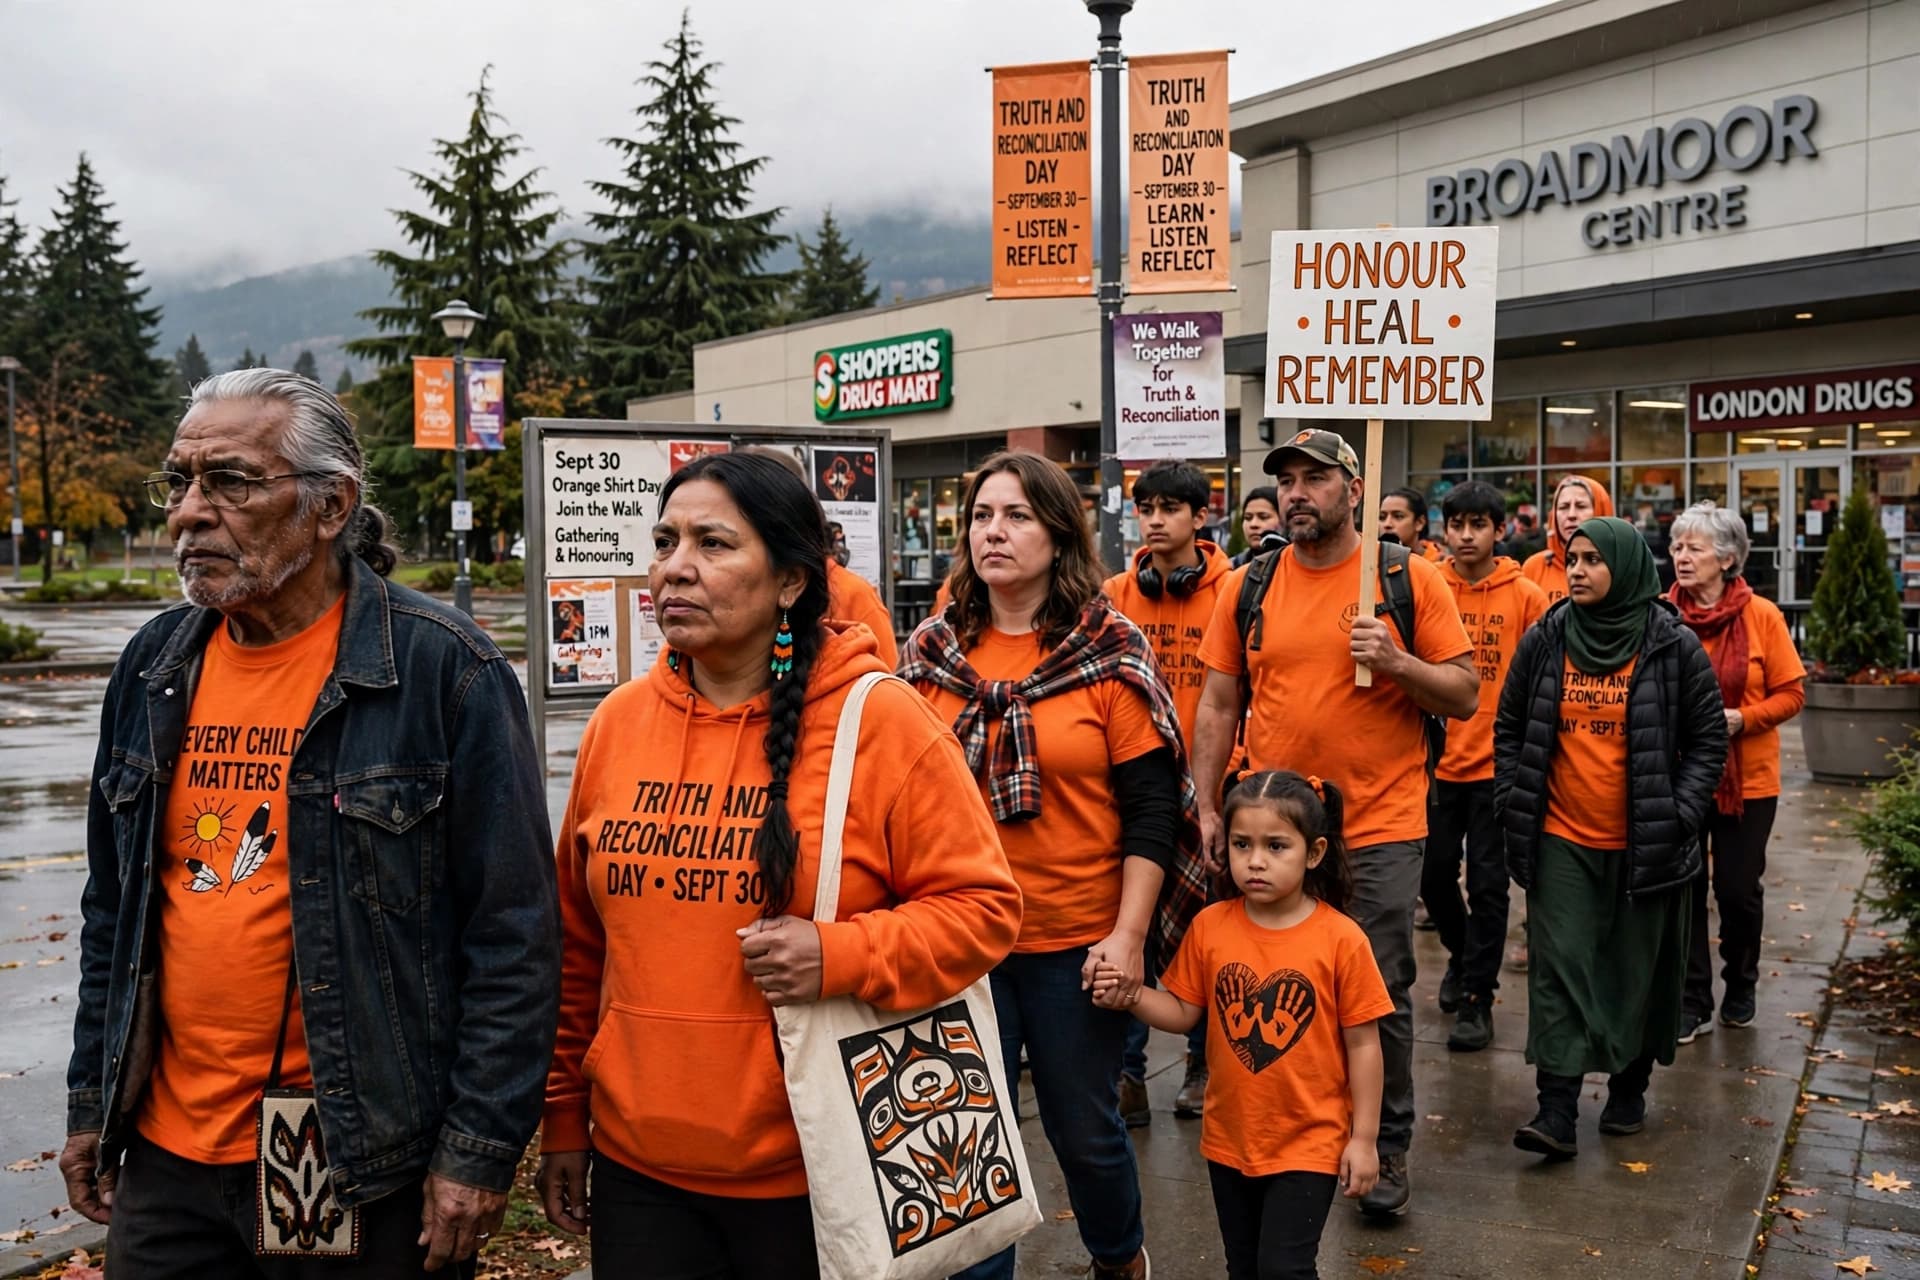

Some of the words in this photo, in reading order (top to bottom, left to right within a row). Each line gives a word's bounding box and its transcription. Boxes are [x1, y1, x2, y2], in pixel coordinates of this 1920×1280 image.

[1147, 77, 1205, 105] TRUTH
[1000, 99, 1051, 126] TRUTH
[1056, 98, 1085, 124] AND
[1164, 109, 1189, 128] AND
[998, 131, 1087, 155] RECONCILIATION
[1133, 129, 1223, 152] RECONCILIATION
[1025, 159, 1059, 184] DAY
[1162, 153, 1195, 177] DAY
[1426, 94, 1819, 227] BROADMOOR
[1008, 193, 1062, 210] SEPTEMBER
[1064, 191, 1077, 208] 30
[1144, 182, 1199, 200] SEPTEMBER
[1202, 181, 1214, 197] 30
[1147, 202, 1204, 225] LEARN
[1581, 184, 1748, 249] CENTRE
[1017, 219, 1067, 238] LISTEN
[1150, 226, 1208, 248] LISTEN
[1006, 243, 1078, 267] REFLECT
[1141, 249, 1216, 272] REFLECT
[1293, 240, 1467, 290] HONOUR
[1131, 323, 1157, 341] We
[1161, 321, 1200, 340] Walk
[1324, 299, 1434, 345] HEAL
[838, 337, 940, 382] SHOPPERS
[1132, 342, 1202, 366] Together
[1152, 364, 1174, 382] for
[1277, 355, 1484, 406] REMEMBER
[838, 381, 885, 411] DRUG
[887, 371, 941, 405] MART
[1143, 385, 1181, 402] Truth
[1185, 385, 1196, 401] &
[1697, 385, 1806, 421] LONDON
[1814, 377, 1914, 412] DRUGS
[1122, 405, 1219, 423] Reconciliation
[555, 450, 595, 474] Sept
[599, 452, 620, 470] 30
[552, 477, 600, 496] Orange
[604, 476, 634, 493] Shirt
[638, 478, 661, 496] Day
[556, 500, 584, 516] Join
[587, 500, 608, 516] the
[612, 500, 643, 516] Walk
[555, 526, 619, 546] Gathering
[555, 547, 565, 562] &
[568, 547, 633, 566] Honouring
[589, 625, 609, 639] 1PM
[182, 725, 242, 754] EVERY
[1590, 720, 1616, 736] SEPT
[1618, 722, 1626, 736] 3
[188, 760, 282, 791] MATTERS
[721, 785, 769, 818] AND
[607, 862, 648, 897] DAY
[673, 868, 729, 903] SEPT
[735, 871, 765, 905] 30
